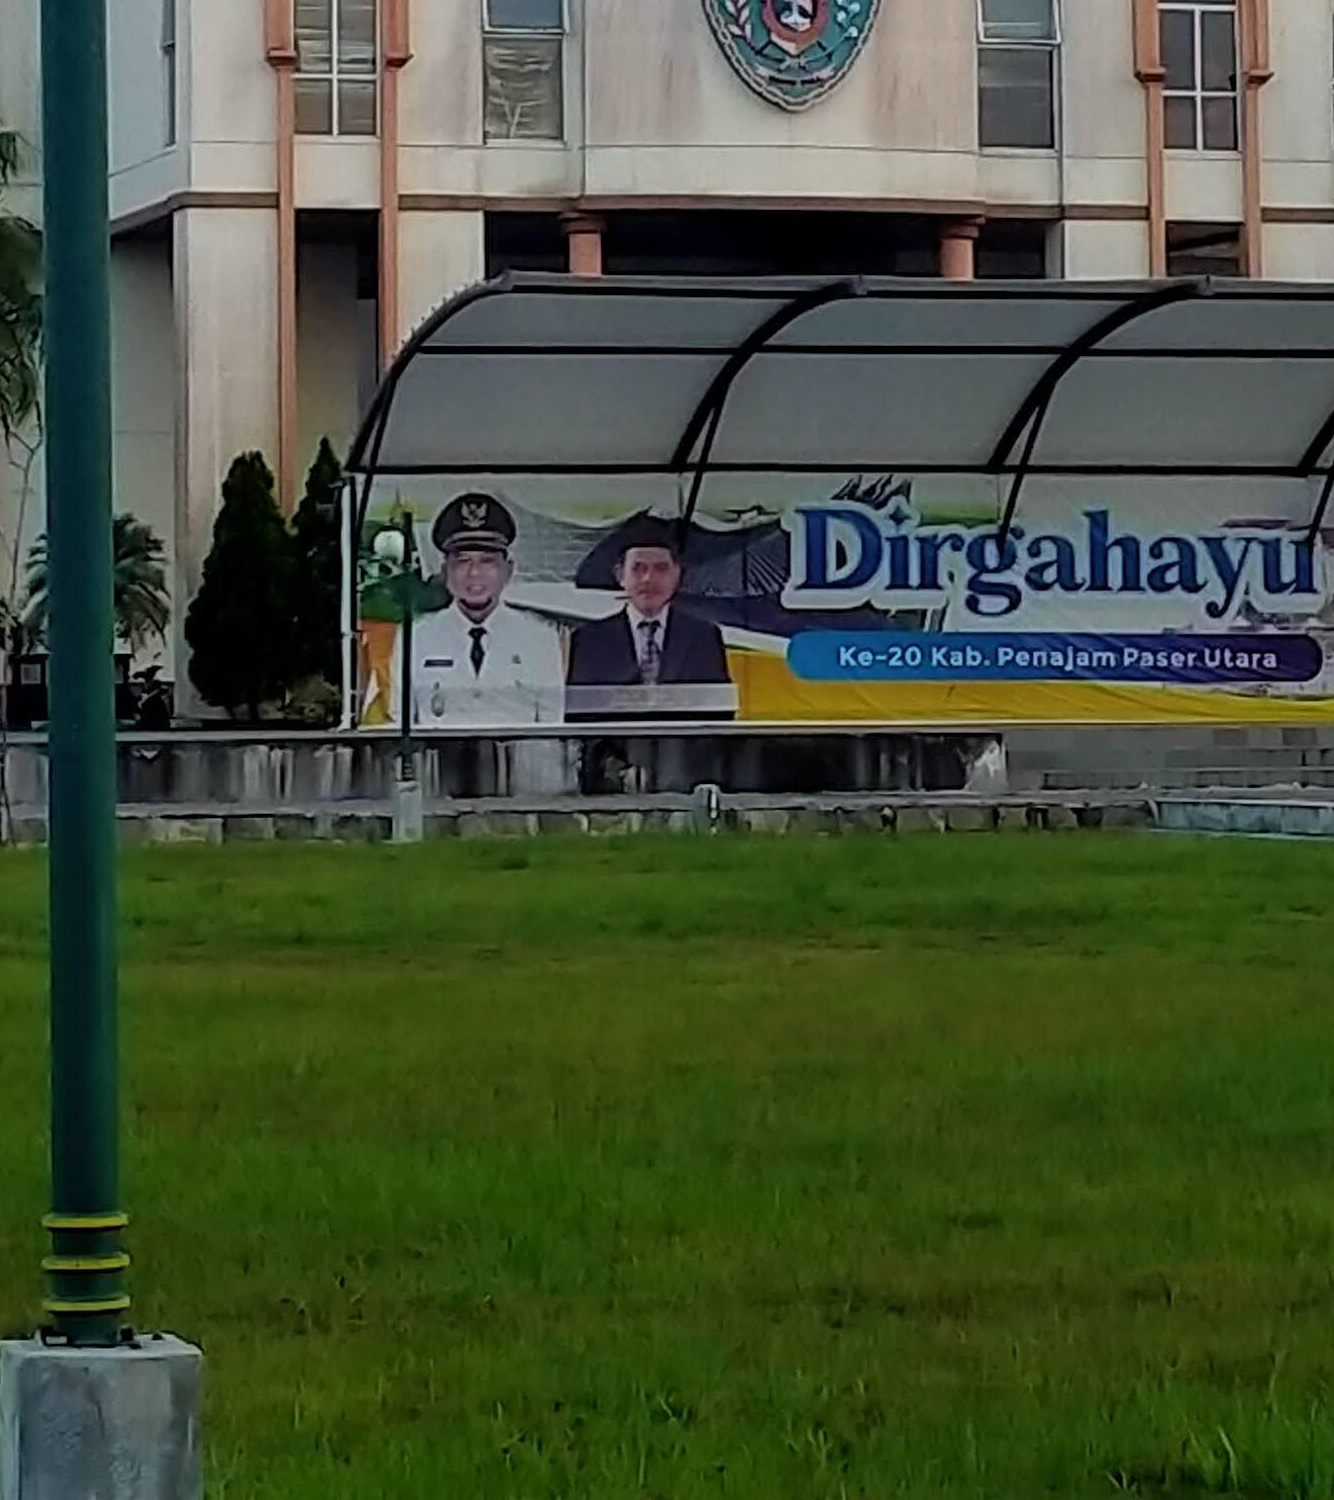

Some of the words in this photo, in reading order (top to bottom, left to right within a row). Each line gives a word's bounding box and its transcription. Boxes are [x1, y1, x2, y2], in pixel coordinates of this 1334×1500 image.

[796, 502, 1319, 618] Dirgahayu
[839, 646, 922, 668] Ke-20
[931, 645, 991, 668] Kab.
[997, 646, 1117, 672] Penajam
[1123, 647, 1198, 669] Paser
[1204, 648, 1278, 669] Utara
